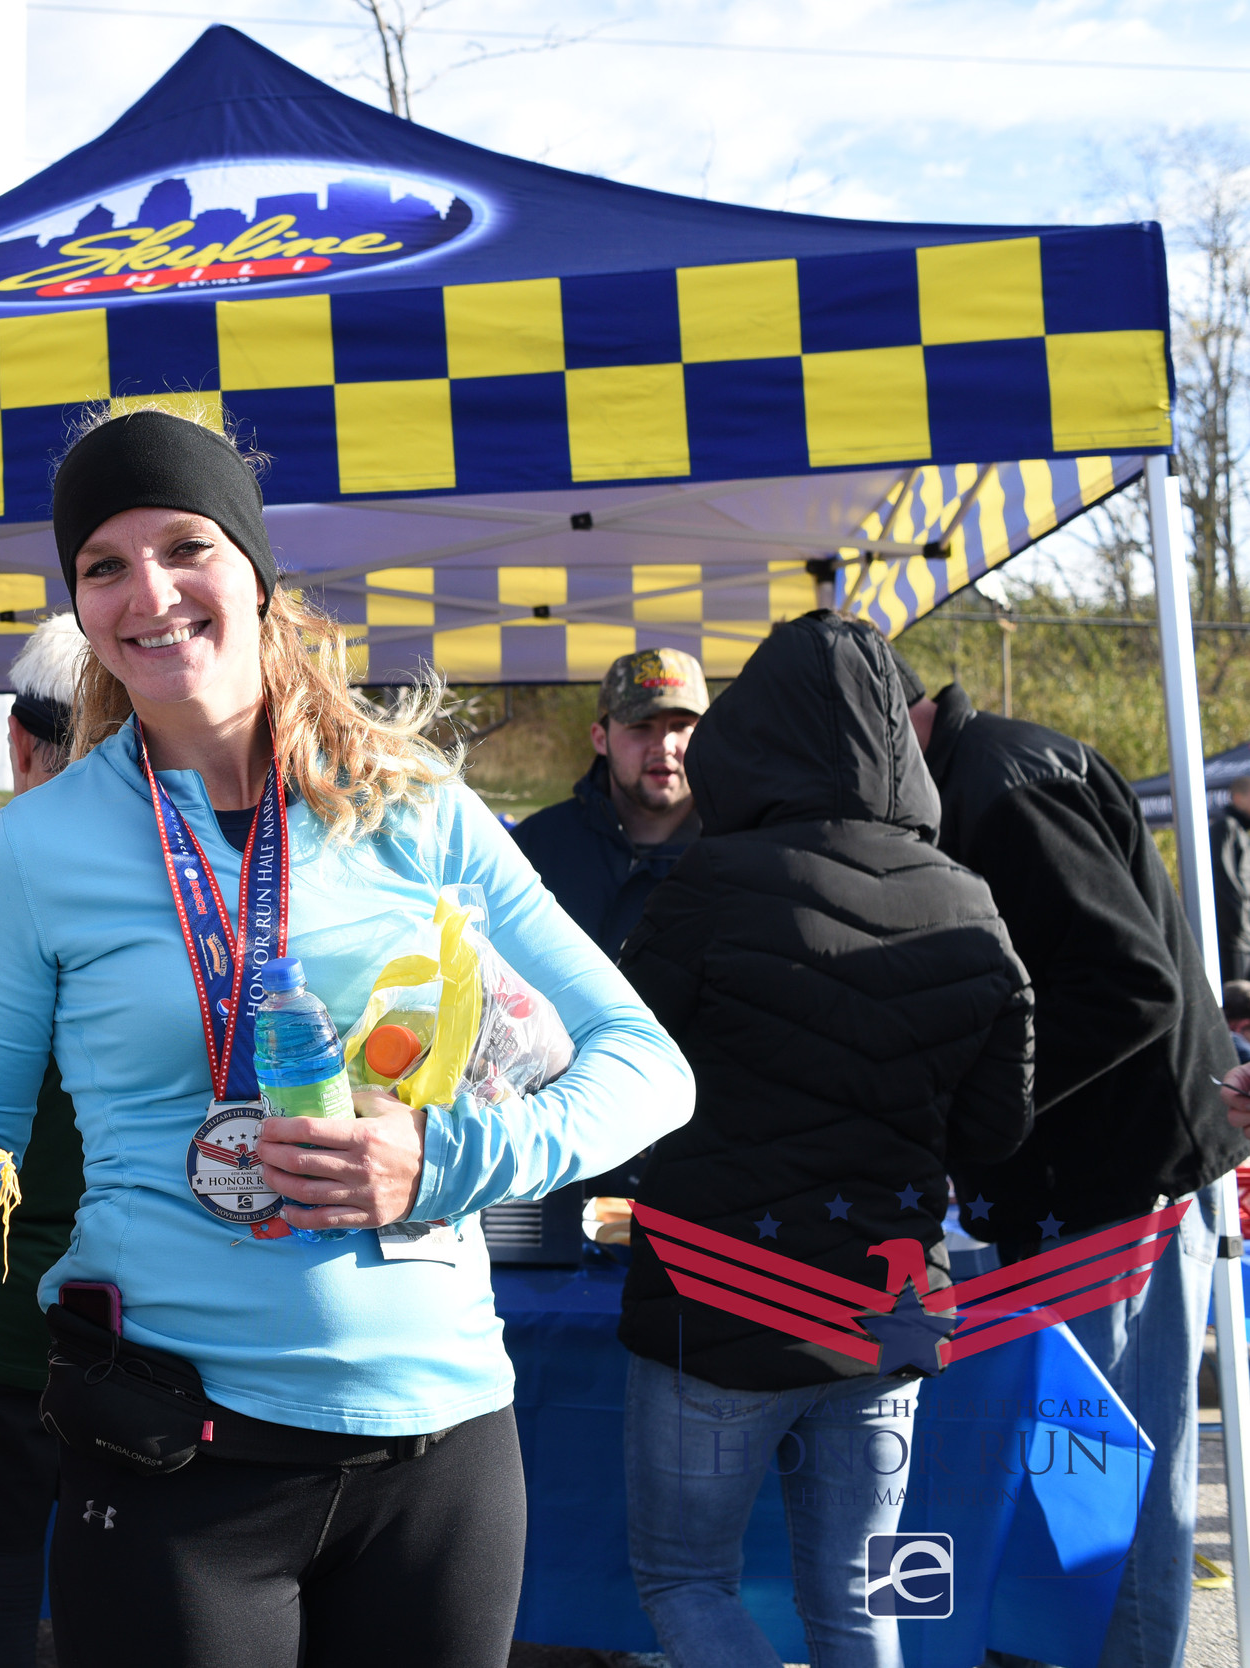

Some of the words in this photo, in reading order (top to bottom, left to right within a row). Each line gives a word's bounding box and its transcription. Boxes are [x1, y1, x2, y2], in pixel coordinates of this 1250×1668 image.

[62, 258, 306, 293] CHILI
[257, 844, 274, 881] HALF
[190, 880, 207, 915] BOSCH
[255, 888, 272, 928] RUN
[206, 1110, 244, 1129] ELIZABETH
[209, 1176, 253, 1186] HONOR
[215, 1208, 251, 1220] NOVEMBER
